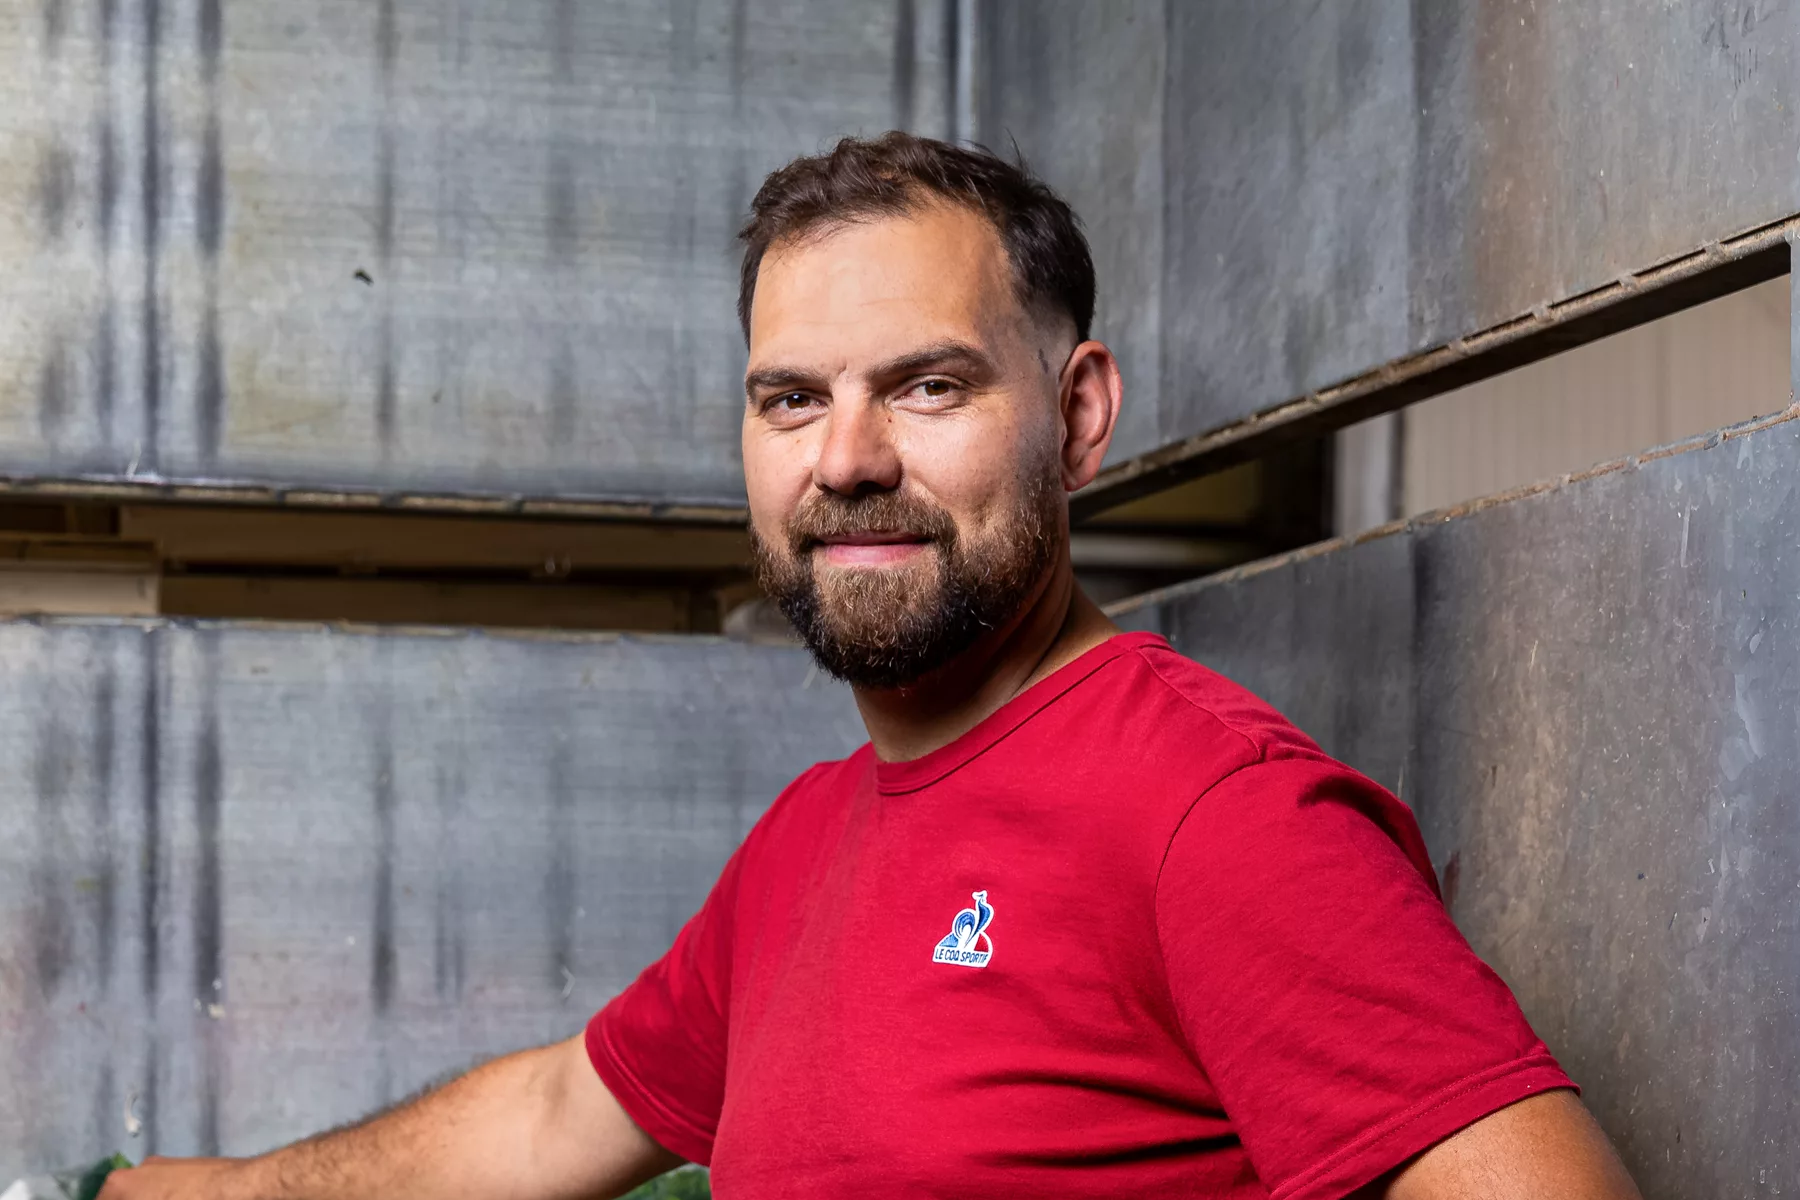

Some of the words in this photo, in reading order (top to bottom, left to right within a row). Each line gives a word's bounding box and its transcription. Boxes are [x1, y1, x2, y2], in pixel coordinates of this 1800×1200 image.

[935, 949, 944, 959] LE
[945, 949, 960, 961] COQ
[960, 951, 988, 963] SPORTIF
